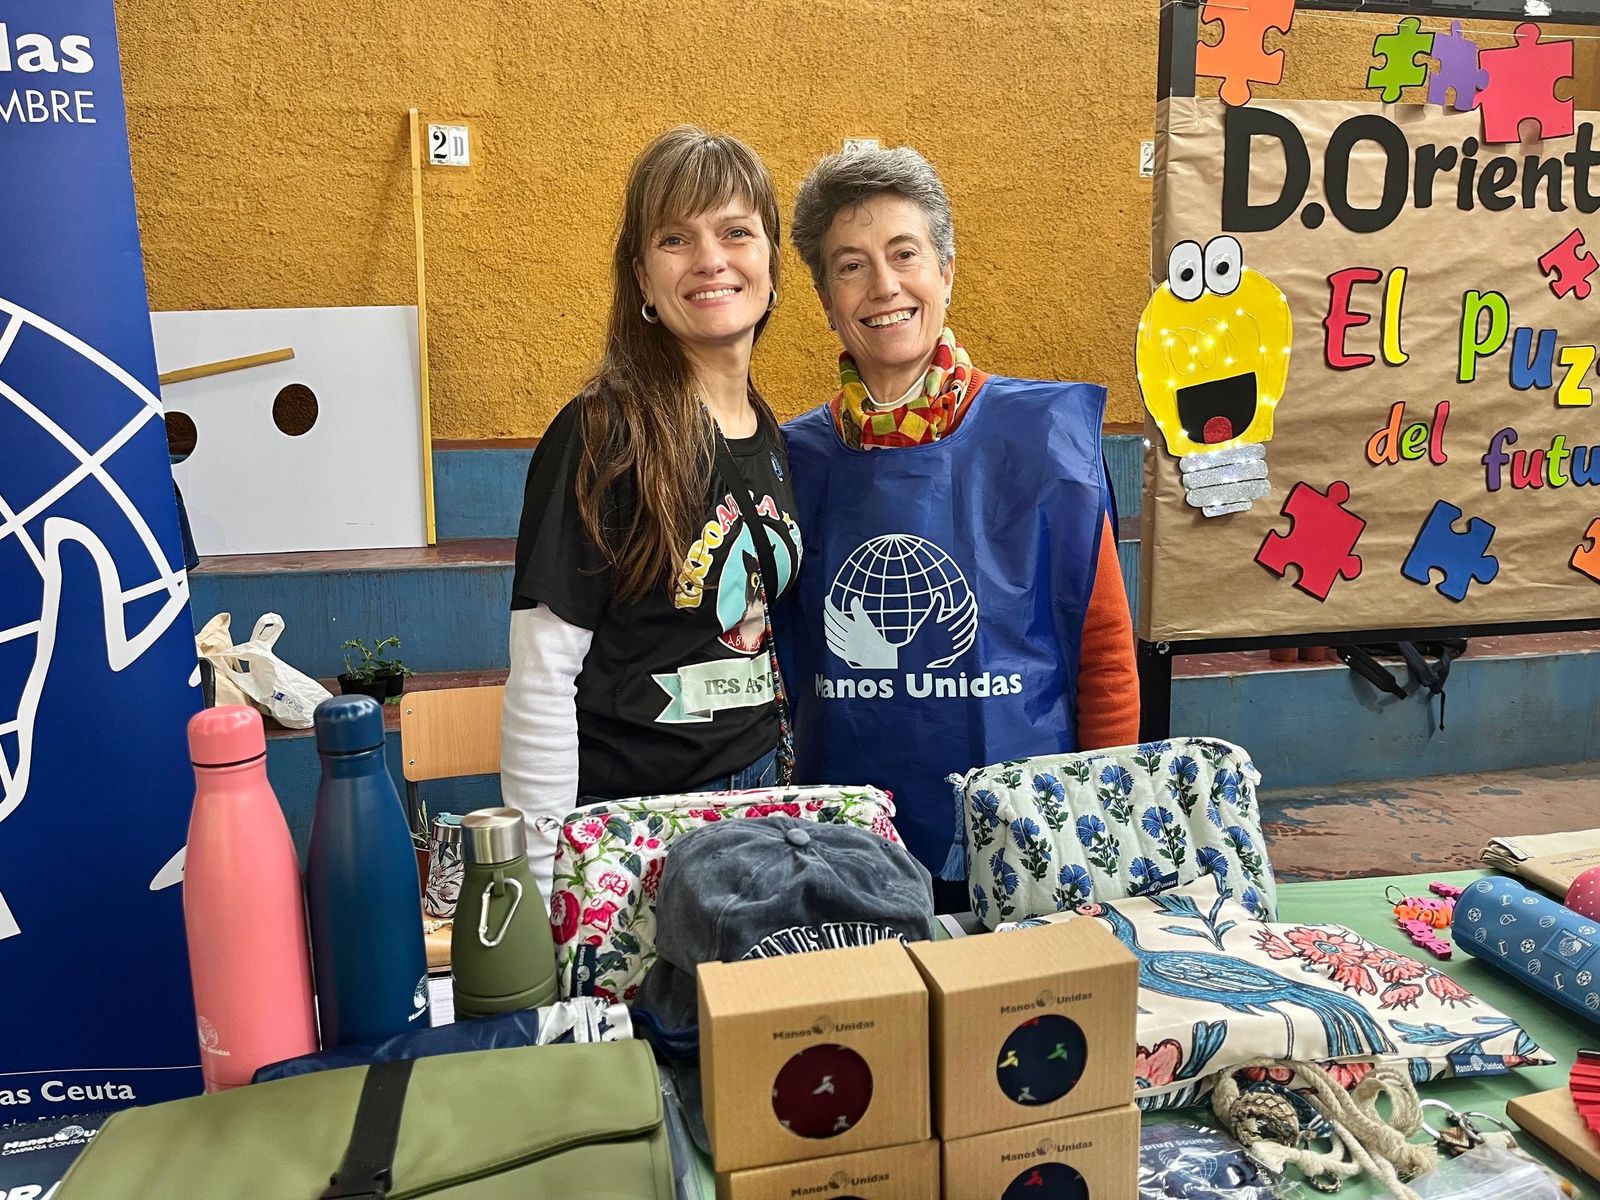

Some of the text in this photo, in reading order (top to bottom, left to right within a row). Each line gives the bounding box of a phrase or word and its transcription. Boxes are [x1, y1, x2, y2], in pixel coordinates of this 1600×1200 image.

[1322, 266, 1410, 370] El
[1456, 289, 1600, 407] puz
[1366, 400, 1450, 467] del
[704, 678, 740, 695] IES
[815, 672, 1023, 699] Manos Unidas
[1001, 992, 1093, 1014] Manos Unidas
[773, 1020, 875, 1041] Manos Unidas
[1455, 1065, 1474, 1073] Manos
[41, 1080, 136, 1102] Ceuta
[3, 1129, 99, 1150] Manos U
[49, 1138, 85, 1149] CONTRA
[1001, 1141, 1093, 1163] Manos Unidas
[791, 1172, 890, 1197] Manos Unidas
